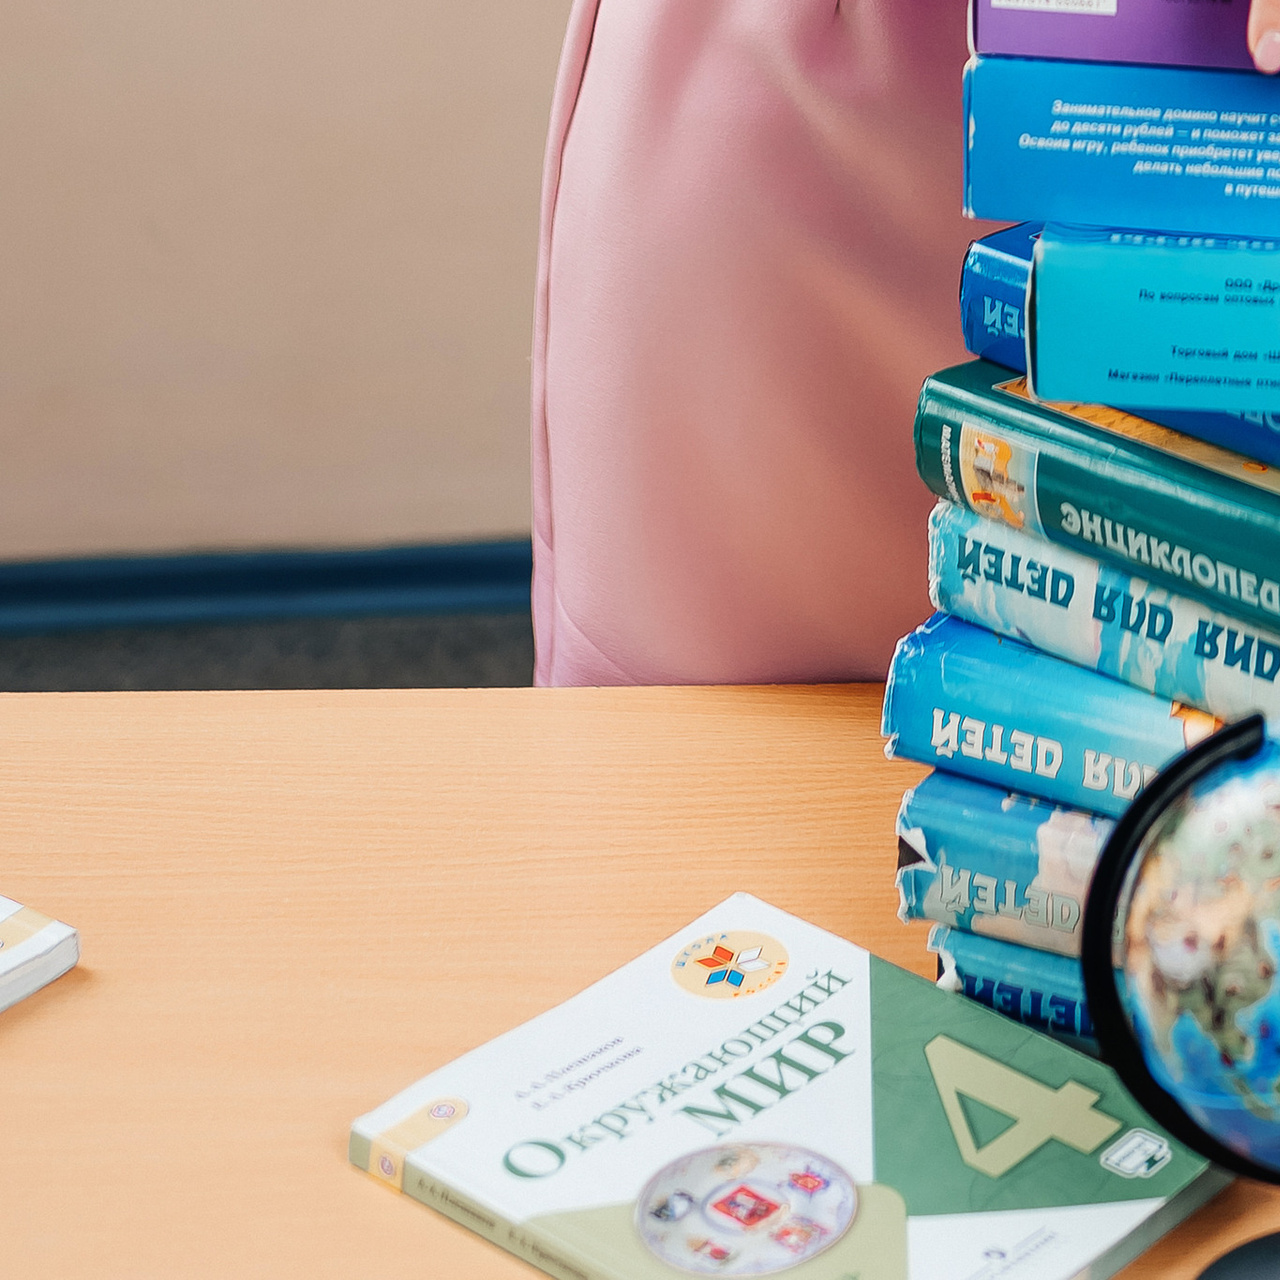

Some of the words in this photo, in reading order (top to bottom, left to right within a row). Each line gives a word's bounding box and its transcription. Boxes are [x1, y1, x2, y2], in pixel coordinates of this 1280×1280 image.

[1052, 99, 1161, 119] Занимательное
[1163, 108, 1217, 124] домино
[1219, 111, 1266, 126] научит
[1071, 121, 1121, 137] десяти
[1123, 124, 1174, 140] рублей
[1202, 128, 1264, 142] поможет
[1019, 132, 1070, 150] Освоив
[1072, 138, 1107, 156] игру,
[1111, 140, 1169, 157] ребенок
[1171, 143, 1252, 161] приобретет
[1133, 159, 1182, 175] делать
[1185, 162, 1264, 177] небольшие
[982, 294, 1026, 340] ЕЙ
[1160, 290, 1219, 303] вопросам
[1223, 293, 1275, 304] оптовых
[956, 535, 1076, 610] ДЕТЕЙ
[1091, 577, 1174, 643] ДЛЯ
[929, 707, 1064, 780] ДЕТЕЙ
[938, 864, 1080, 934] ДЕТЕЙ
[500, 967, 854, 1182] Окружающий
[672, 1017, 860, 1139] МИР
[923, 1034, 1124, 1178] 4
